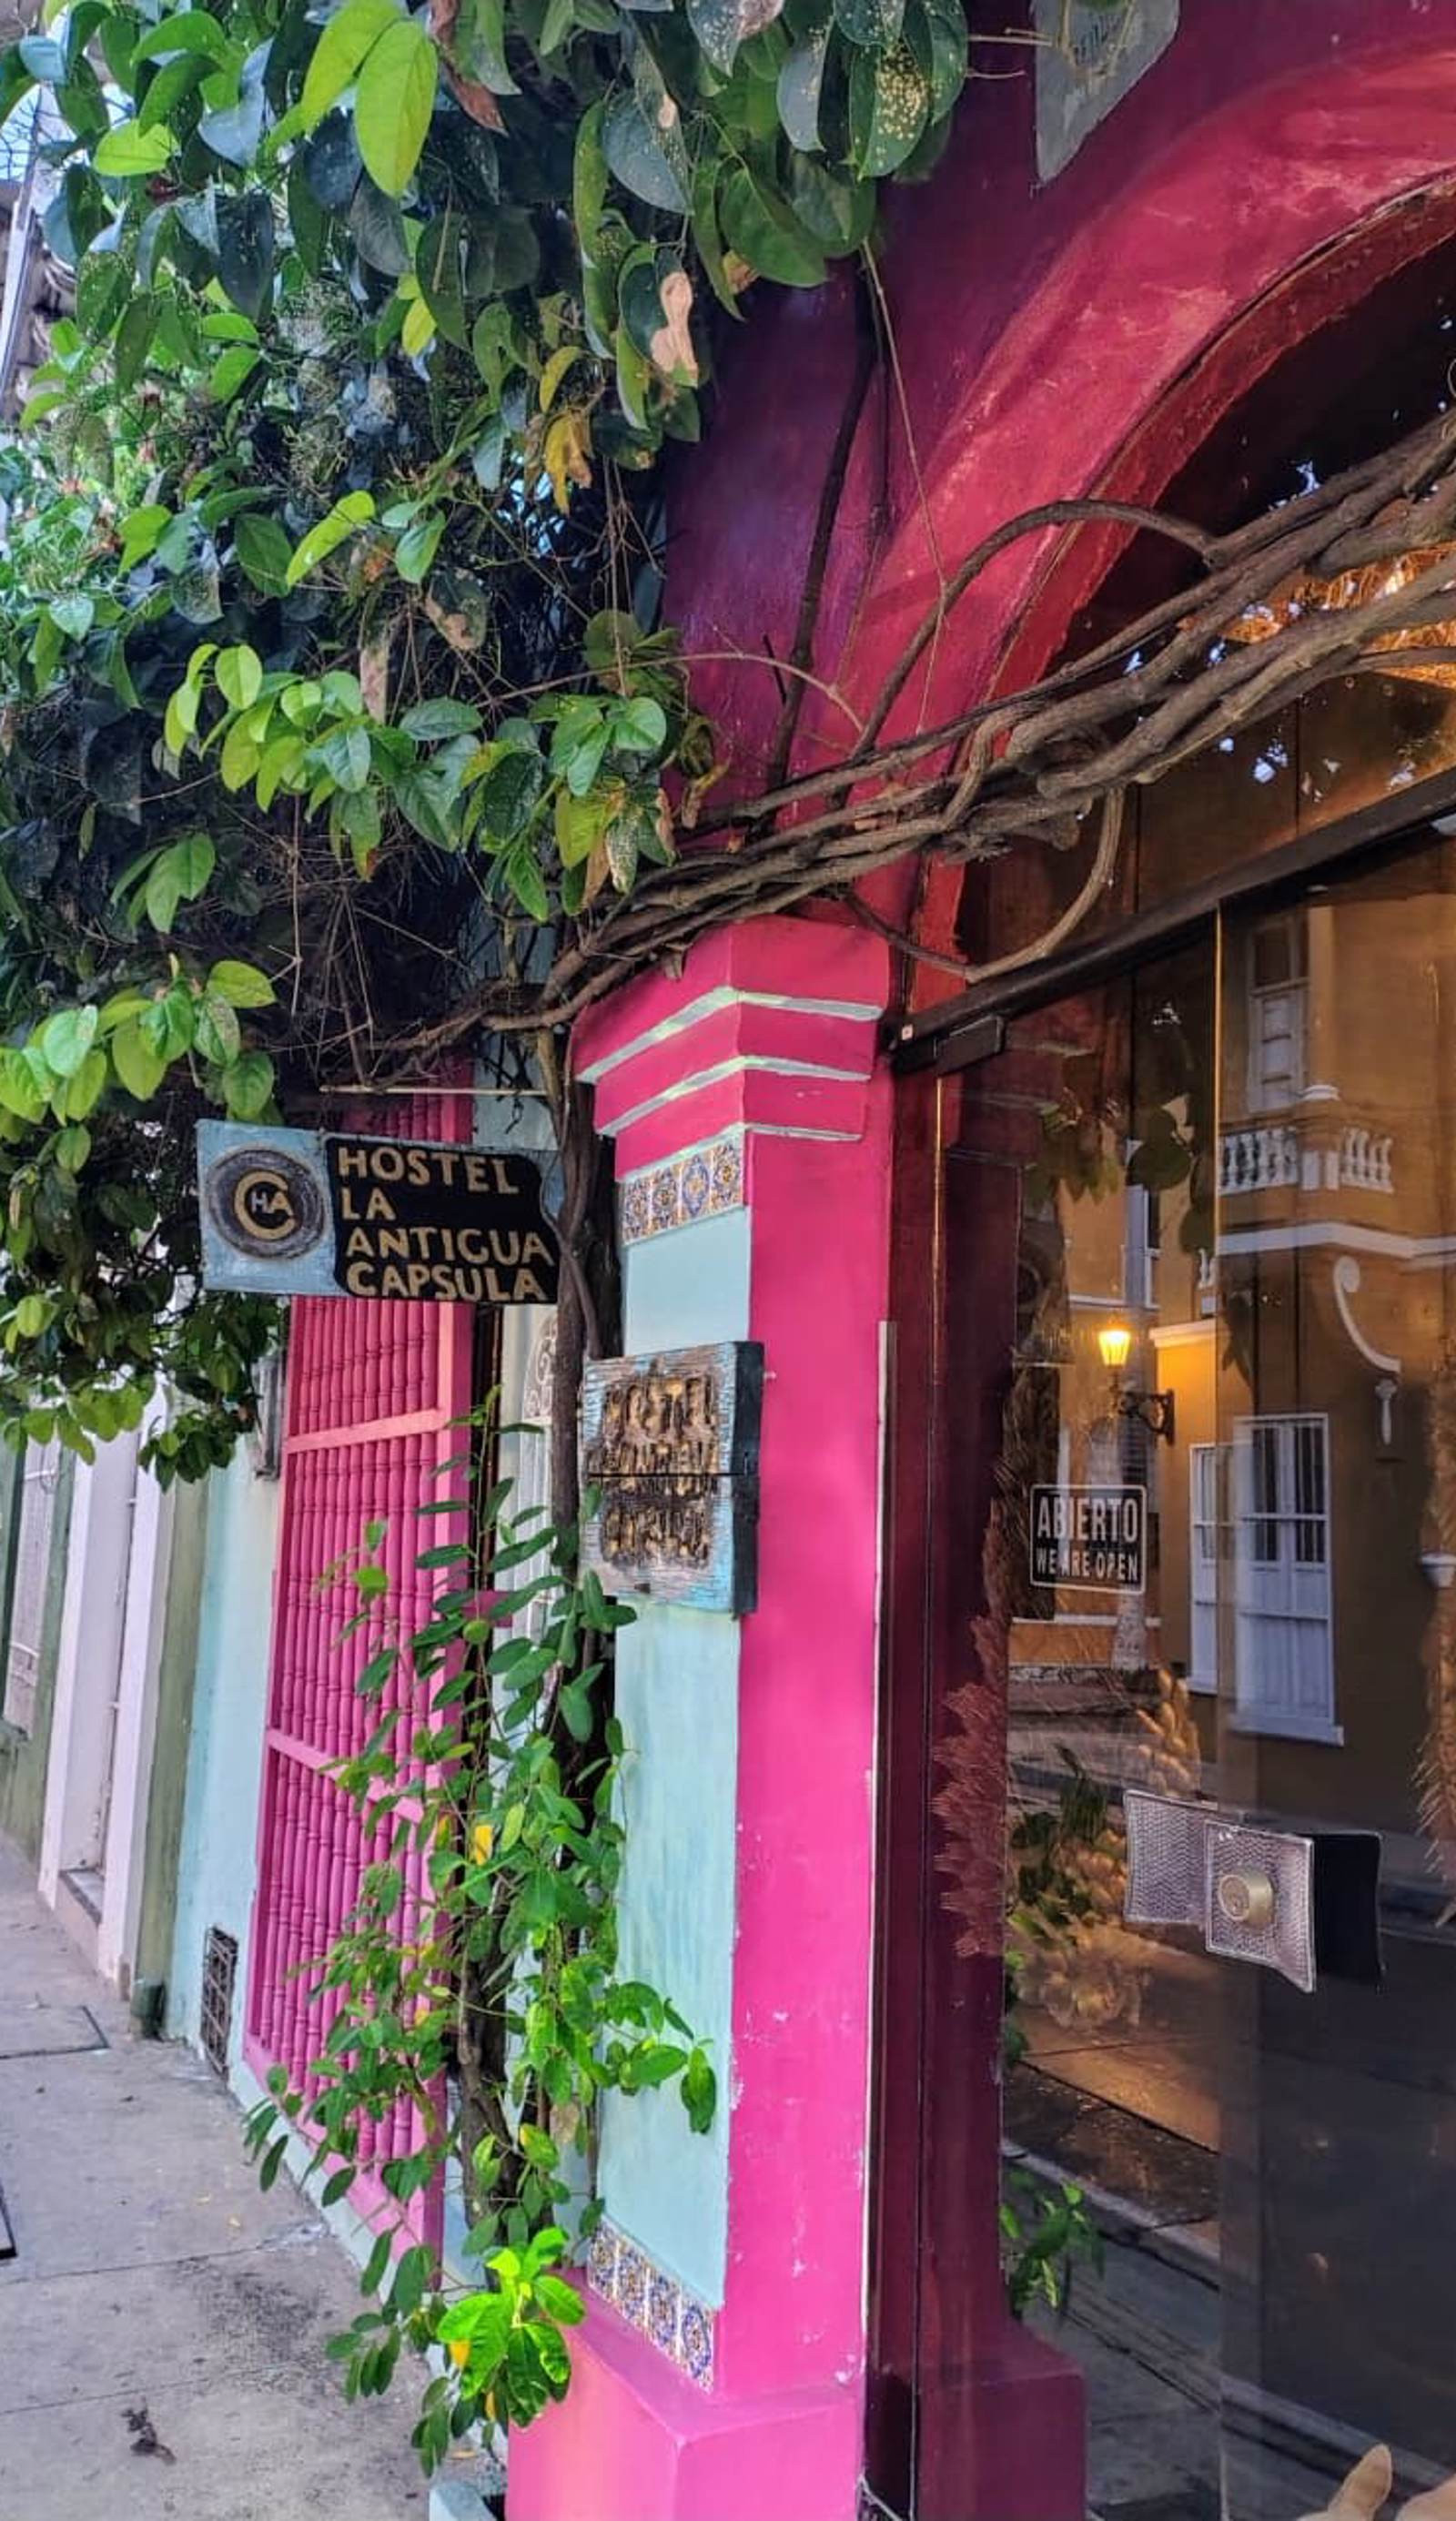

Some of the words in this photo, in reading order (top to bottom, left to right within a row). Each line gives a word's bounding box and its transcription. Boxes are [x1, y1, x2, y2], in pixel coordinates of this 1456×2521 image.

[337, 1147, 521, 1195] HOSTEL
[340, 1187, 397, 1221] LA
[346, 1226, 556, 1268] ANTIGUA
[345, 1262, 549, 1302] CAPSULA
[1036, 1496, 1138, 1543] ABIERTO
[1036, 1547, 1057, 1574] WE
[1060, 1549, 1091, 1577] ARE
[1095, 1551, 1138, 1582] OPEN
